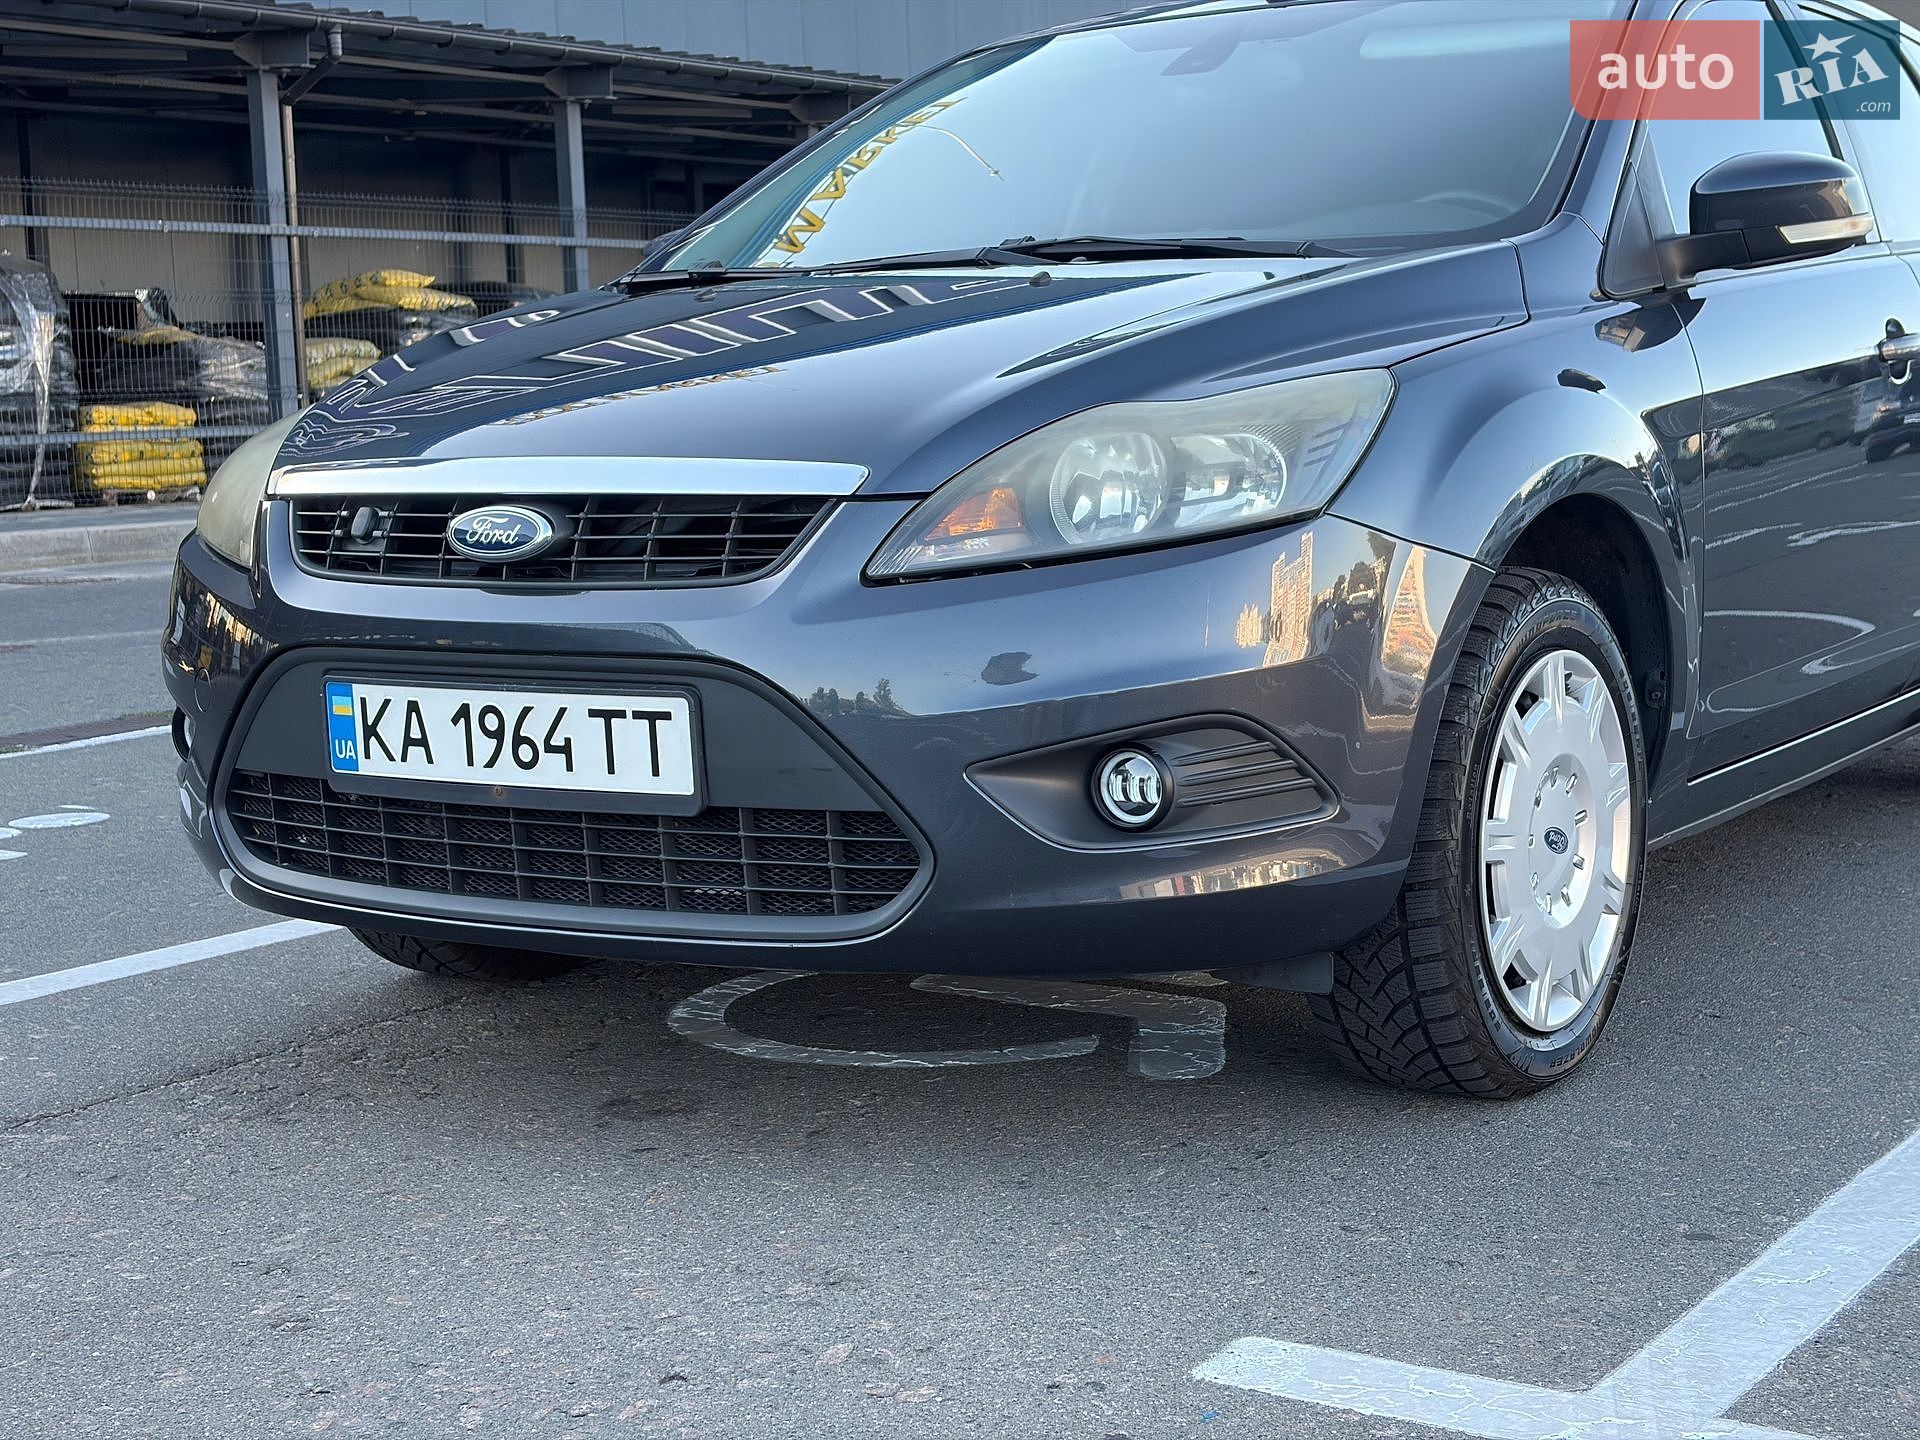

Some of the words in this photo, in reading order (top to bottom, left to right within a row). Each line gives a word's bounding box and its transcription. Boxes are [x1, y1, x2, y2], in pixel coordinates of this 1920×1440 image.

[466, 516, 521, 544] Ford
[335, 739, 356, 760] UA
[360, 697, 434, 764] KA
[450, 703, 573, 772] 1964
[588, 709, 672, 778] TT
